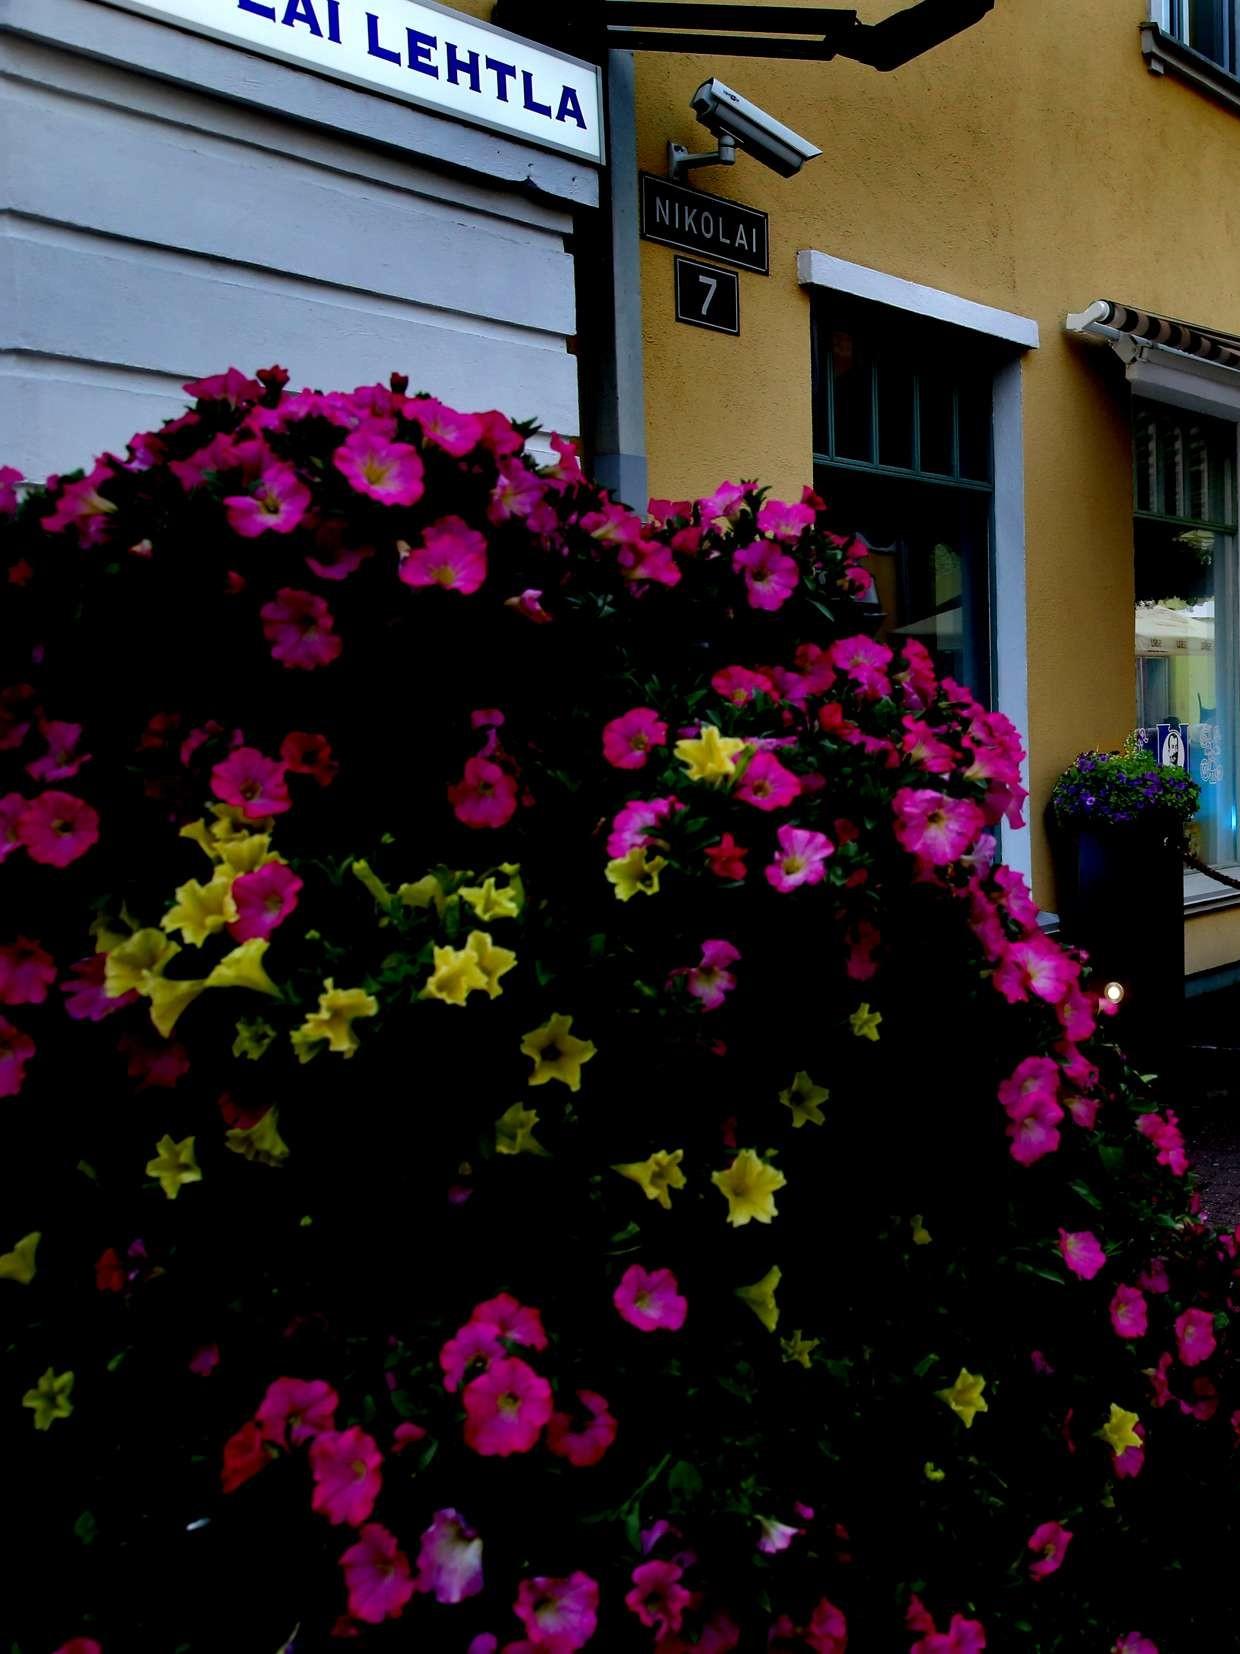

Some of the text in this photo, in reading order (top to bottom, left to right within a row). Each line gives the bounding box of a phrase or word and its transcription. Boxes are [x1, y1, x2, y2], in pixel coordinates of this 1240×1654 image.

[366, 12, 587, 130] LEHTLA
[656, 196, 756, 253] NIKOLAI
[699, 274, 717, 316] 7
